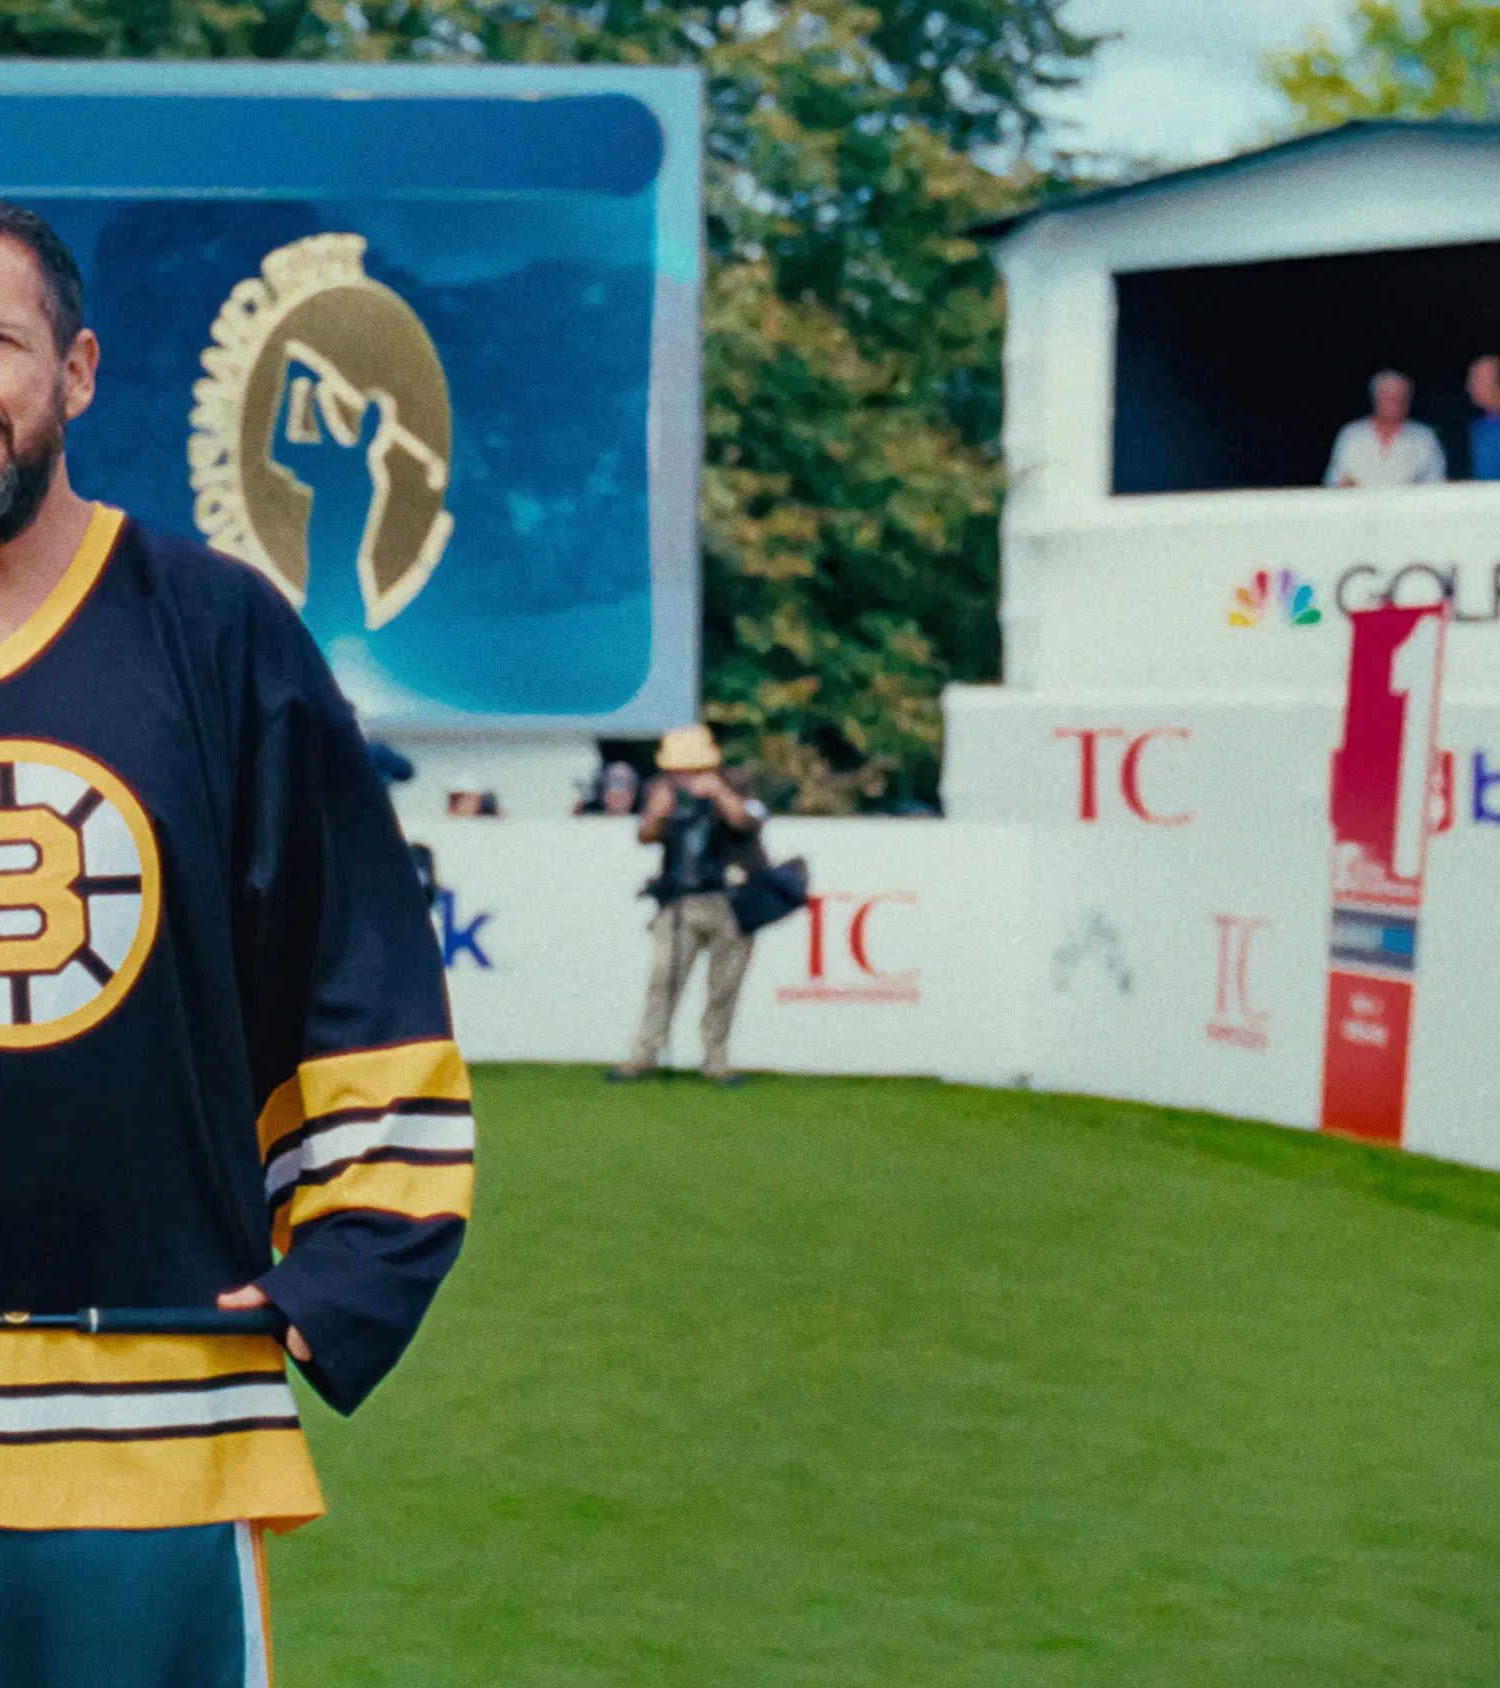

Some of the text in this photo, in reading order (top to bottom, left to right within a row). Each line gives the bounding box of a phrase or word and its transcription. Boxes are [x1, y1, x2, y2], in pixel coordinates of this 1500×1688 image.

[1337, 564, 1500, 622] GOL
[1054, 727, 1195, 827] TC
[1388, 614, 1442, 878] 1
